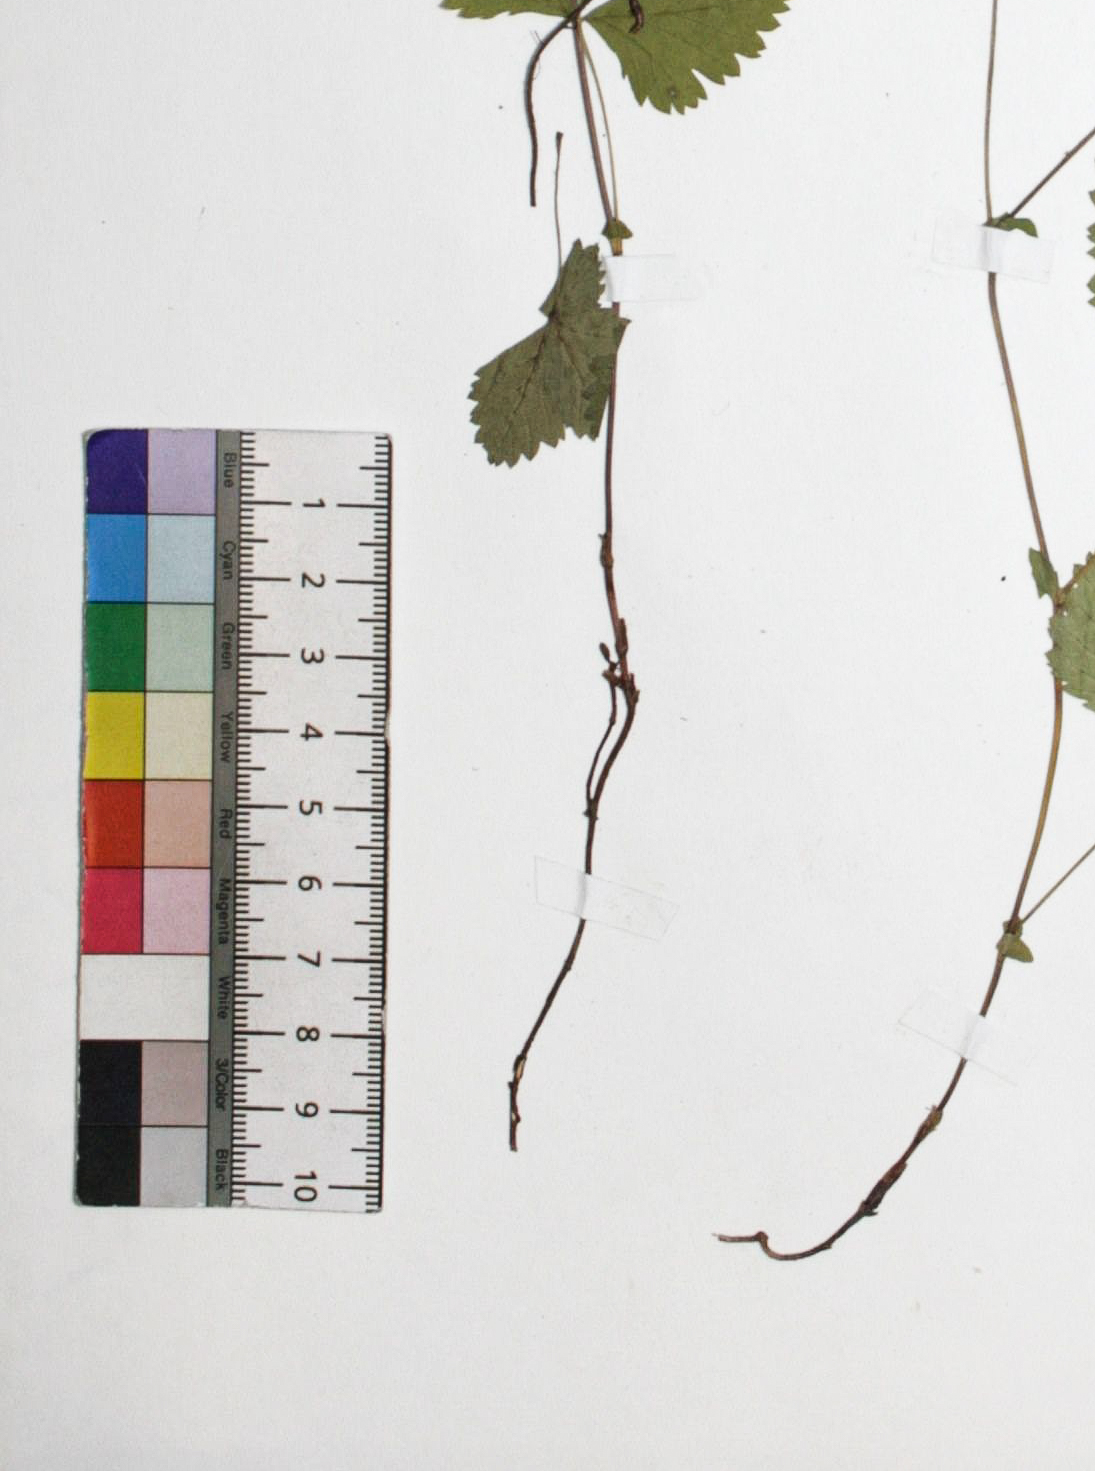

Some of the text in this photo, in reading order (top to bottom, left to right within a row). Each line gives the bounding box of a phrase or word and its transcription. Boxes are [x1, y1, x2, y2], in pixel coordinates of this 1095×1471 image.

[223, 451, 238, 489] Blue
[301, 497, 326, 510] 1
[220, 540, 237, 581] Cyan
[300, 572, 326, 589] 2
[300, 648, 325, 665] 3
[220, 711, 234, 764] Yellow
[300, 723, 324, 742] 4
[298, 800, 323, 816] 5
[218, 808, 233, 840] Red
[297, 875, 323, 892] 6
[215, 878, 232, 945] Magenta
[297, 951, 321, 968] 7
[216, 976, 231, 1020] White
[295, 1026, 321, 1043] 8
[295, 1102, 320, 1119] 9
[214, 1148, 229, 1191] Black
[293, 1170, 318, 1203] 10
